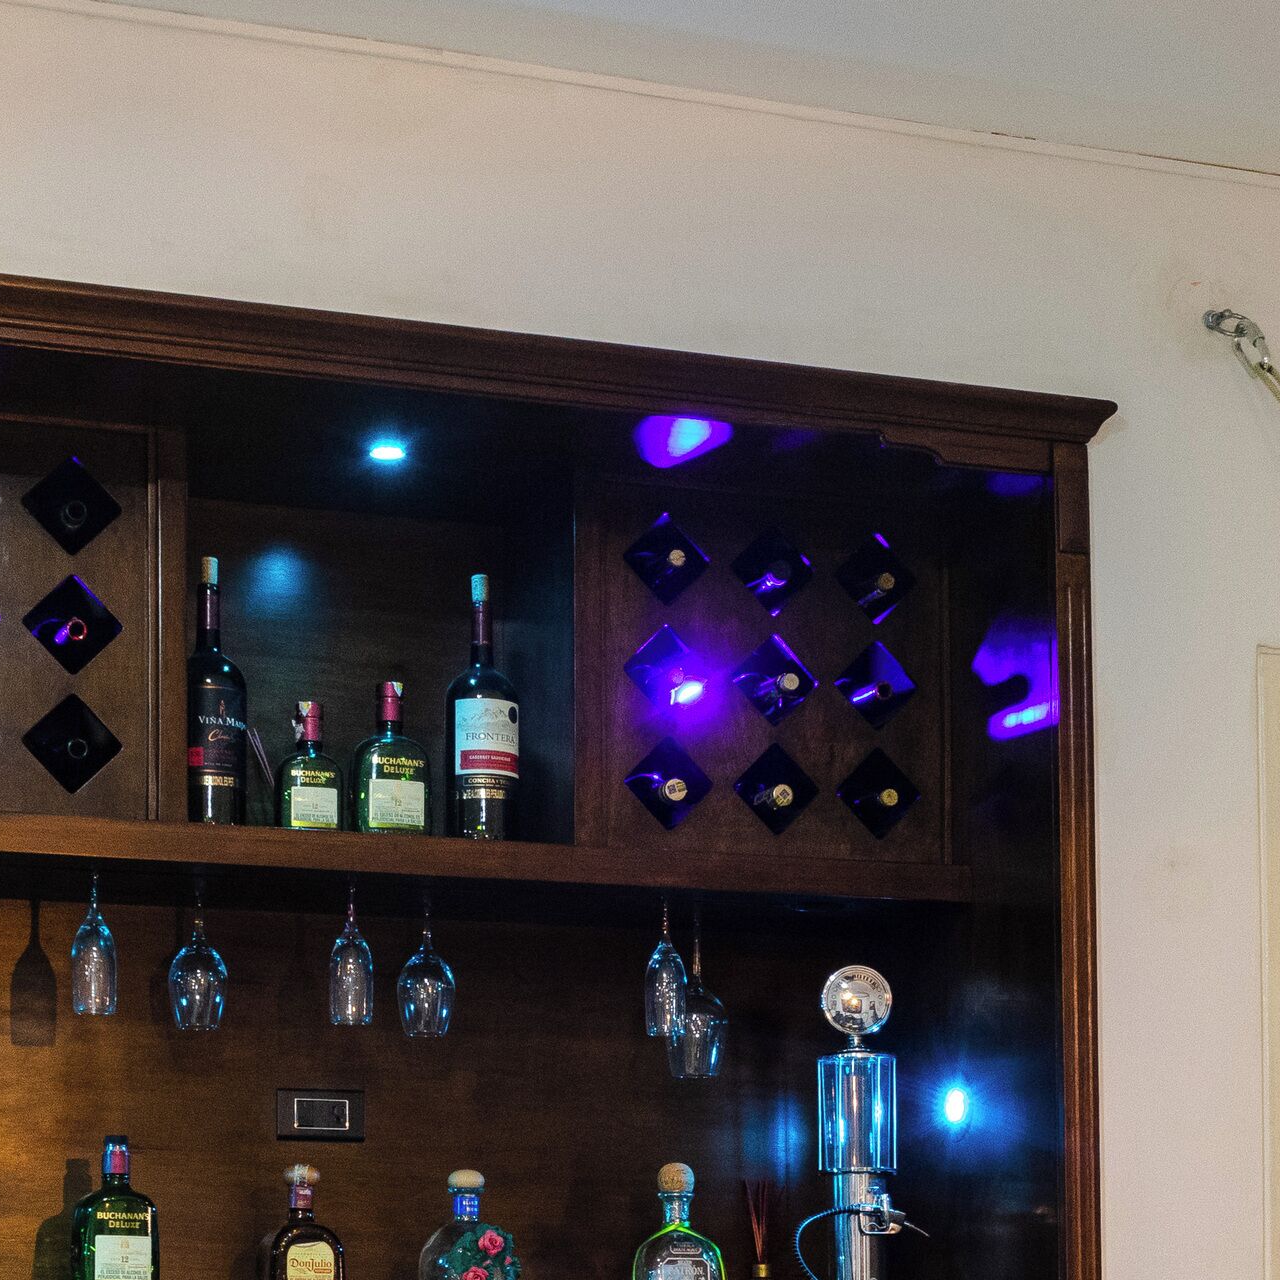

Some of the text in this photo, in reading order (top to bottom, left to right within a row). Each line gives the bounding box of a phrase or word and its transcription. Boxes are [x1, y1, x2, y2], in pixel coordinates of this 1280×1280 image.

[198, 715, 223, 725] VIÑA
[465, 731, 516, 744] FRONTERA
[291, 769, 336, 779] BUCHANAN'S
[96, 1211, 149, 1221] BUCHANAN'S
[120, 1255, 129, 1263] 12
